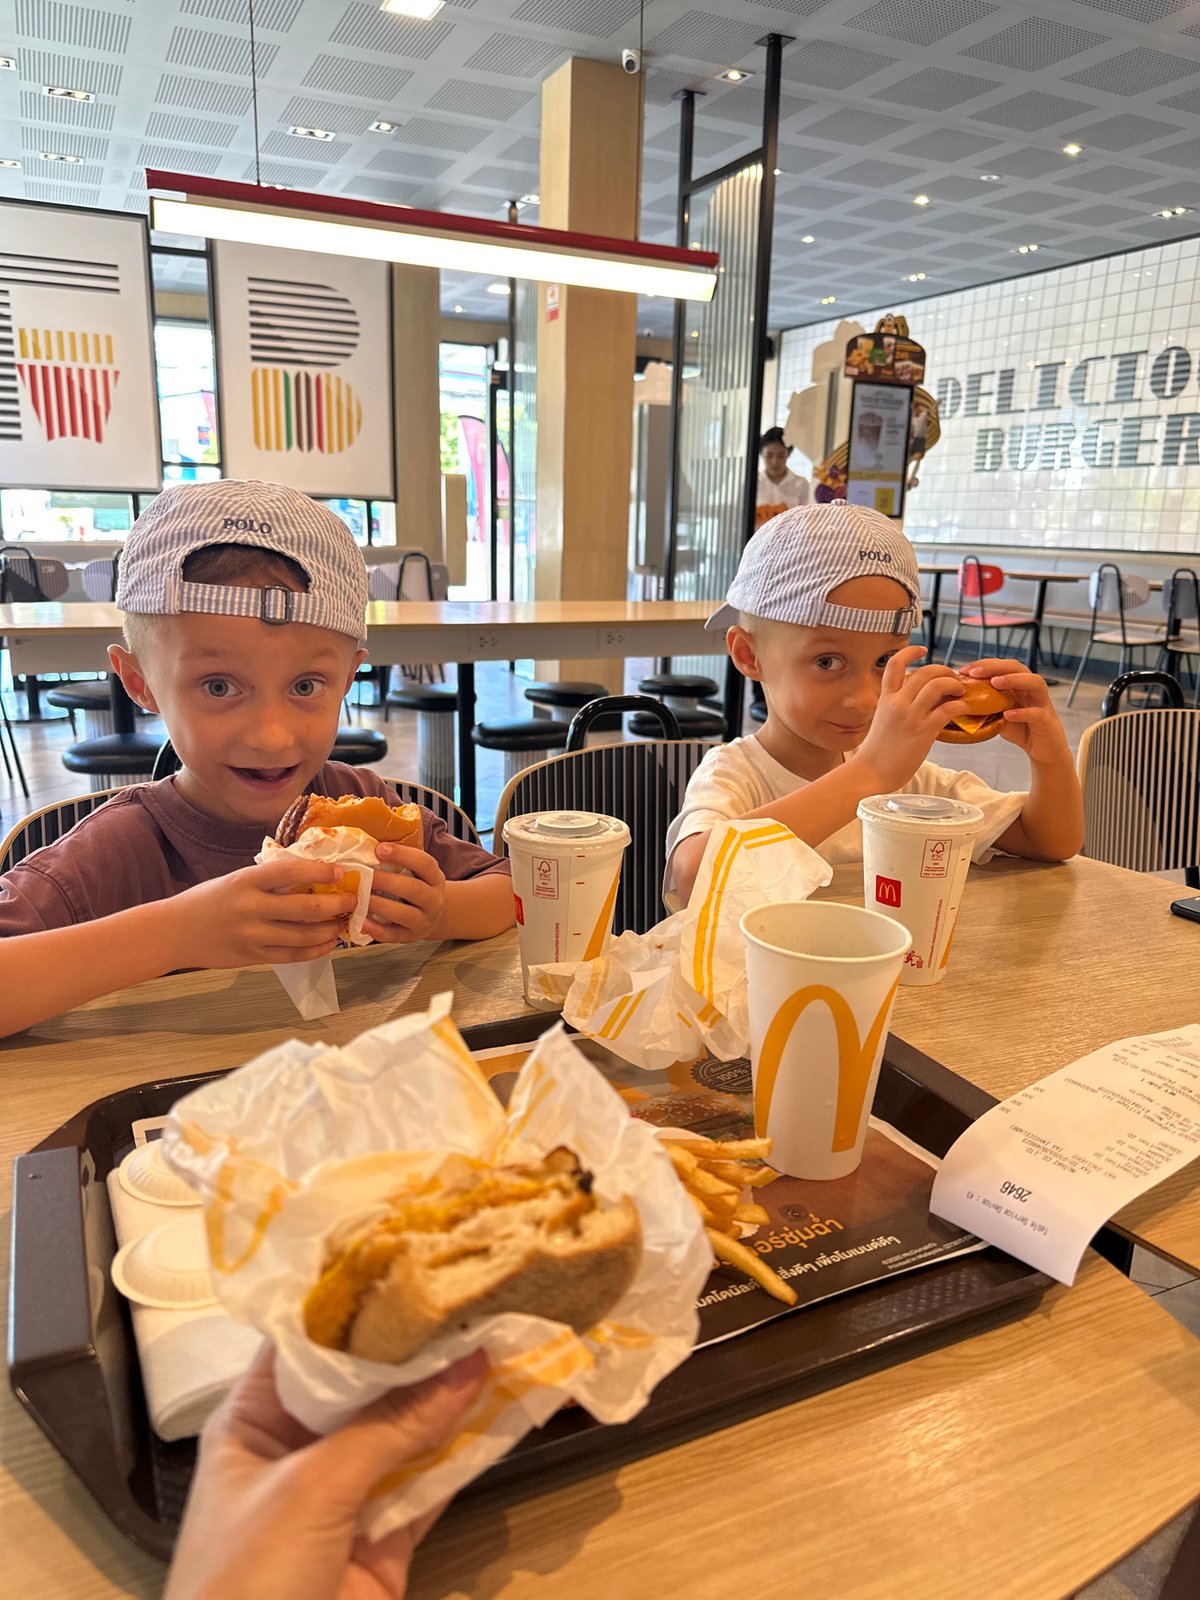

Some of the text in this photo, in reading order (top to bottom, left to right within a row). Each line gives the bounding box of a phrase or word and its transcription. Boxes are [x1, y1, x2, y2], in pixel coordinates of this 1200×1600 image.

[937, 346, 1200, 420] DELICIO
[223, 518, 272, 534] POLO
[858, 550, 892, 563] POLO
[716, 1068, 749, 1082] 100%
[1000, 1180, 1032, 1203] 2646
[980, 1197, 1003, 1214] Device
[1001, 1207, 1029, 1226] Service
[750, 1213, 844, 1258] อร์ชุ่มฉ่ำ
[1028, 1220, 1049, 1236] Table
